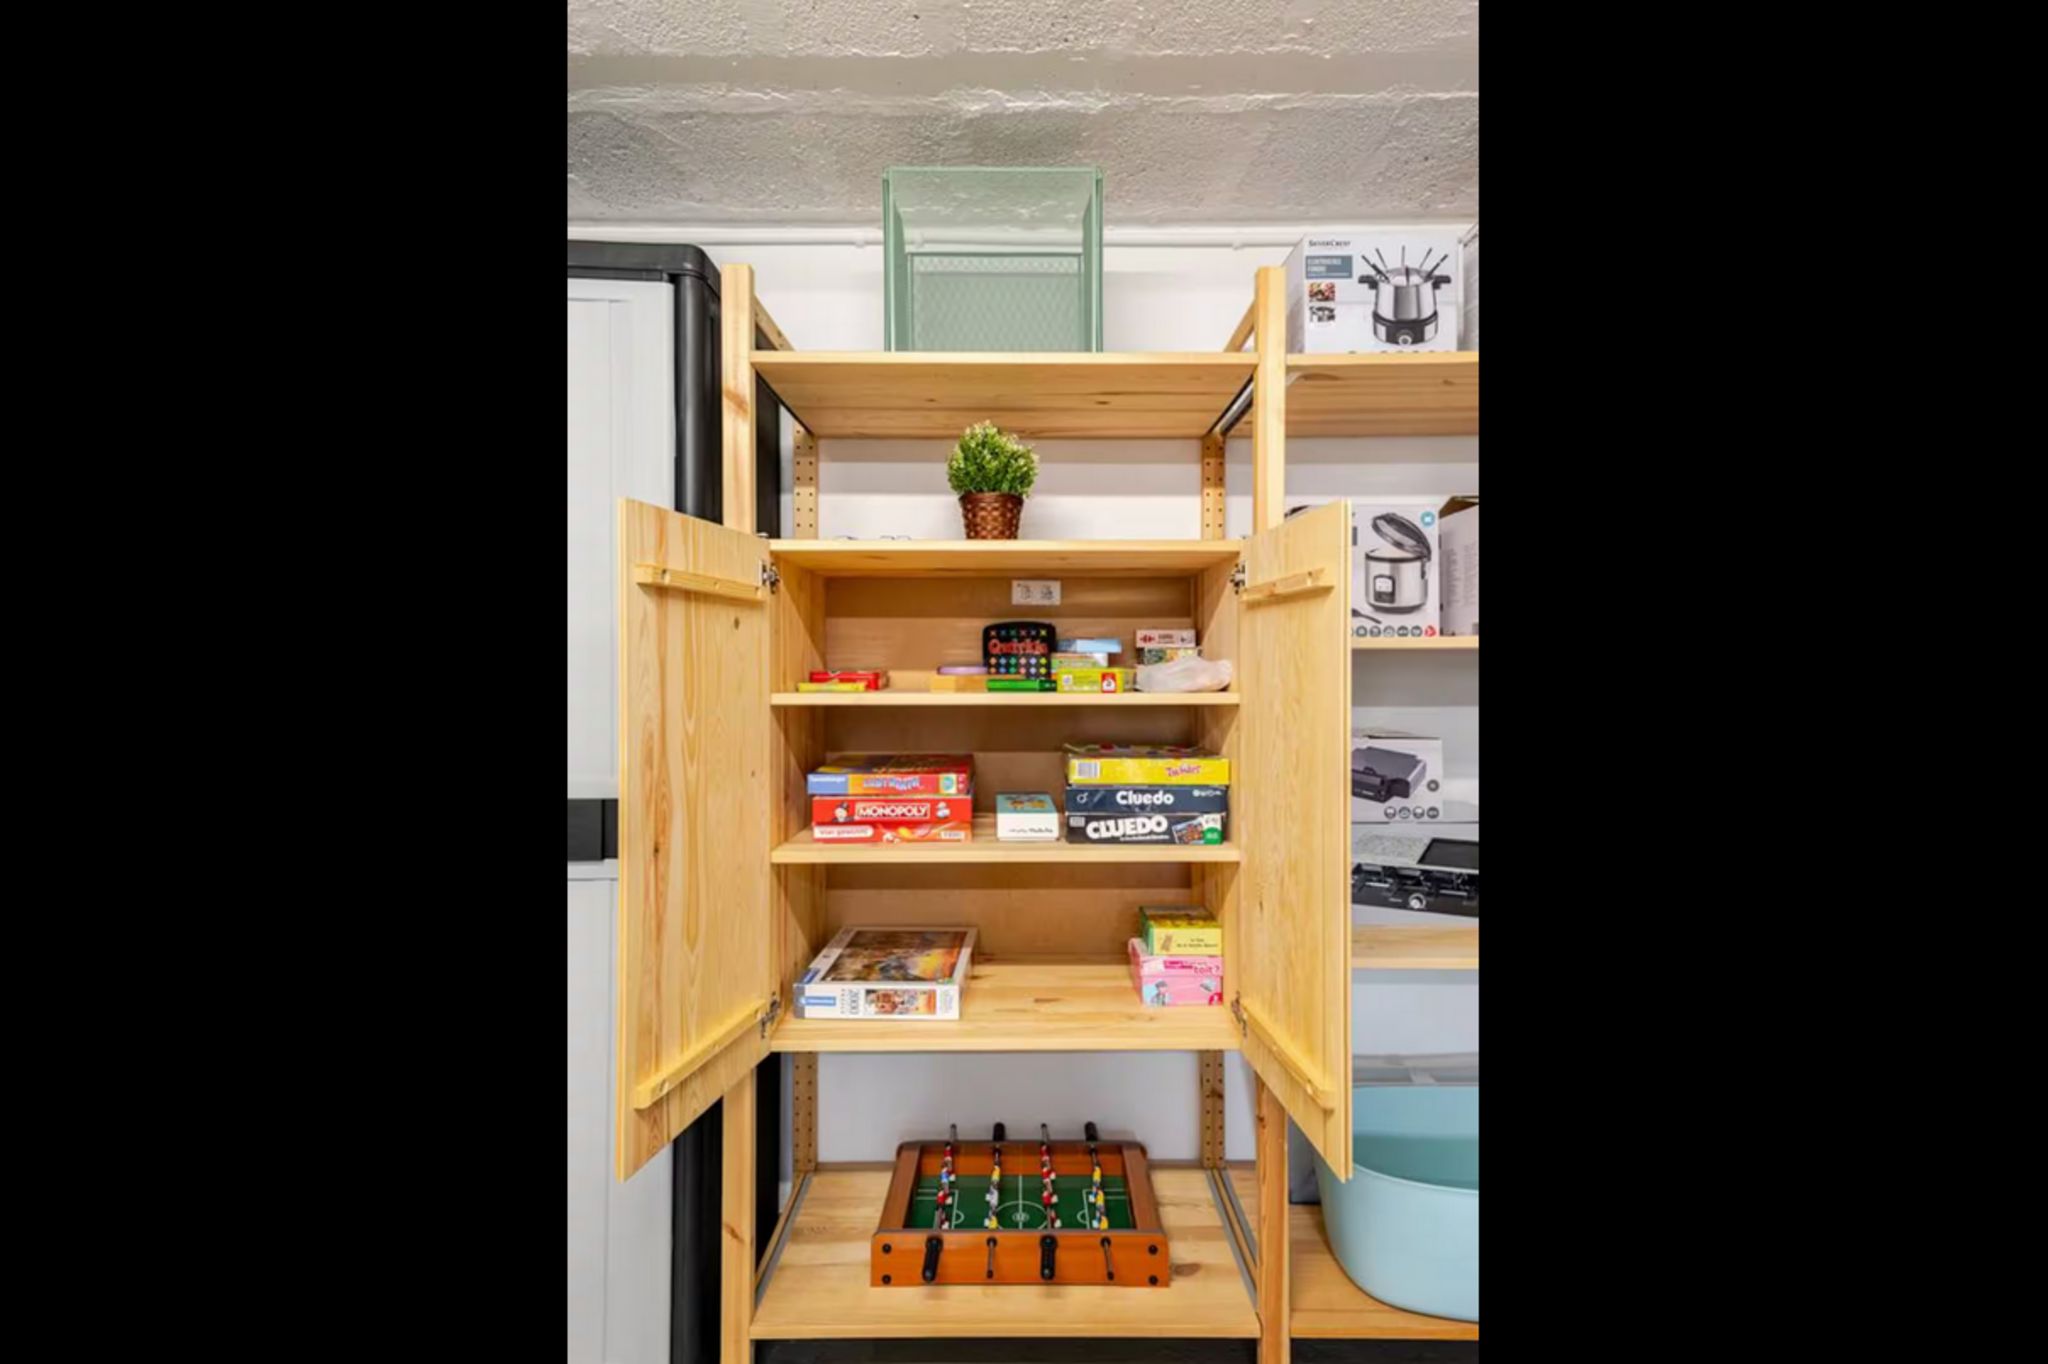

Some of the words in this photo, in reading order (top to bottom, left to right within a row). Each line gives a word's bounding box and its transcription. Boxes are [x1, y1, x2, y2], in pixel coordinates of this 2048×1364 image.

[1116, 790, 1175, 805] Cluedo
[857, 804, 929, 818] MONOPOLY
[1086, 815, 1168, 839] CLUEDO
